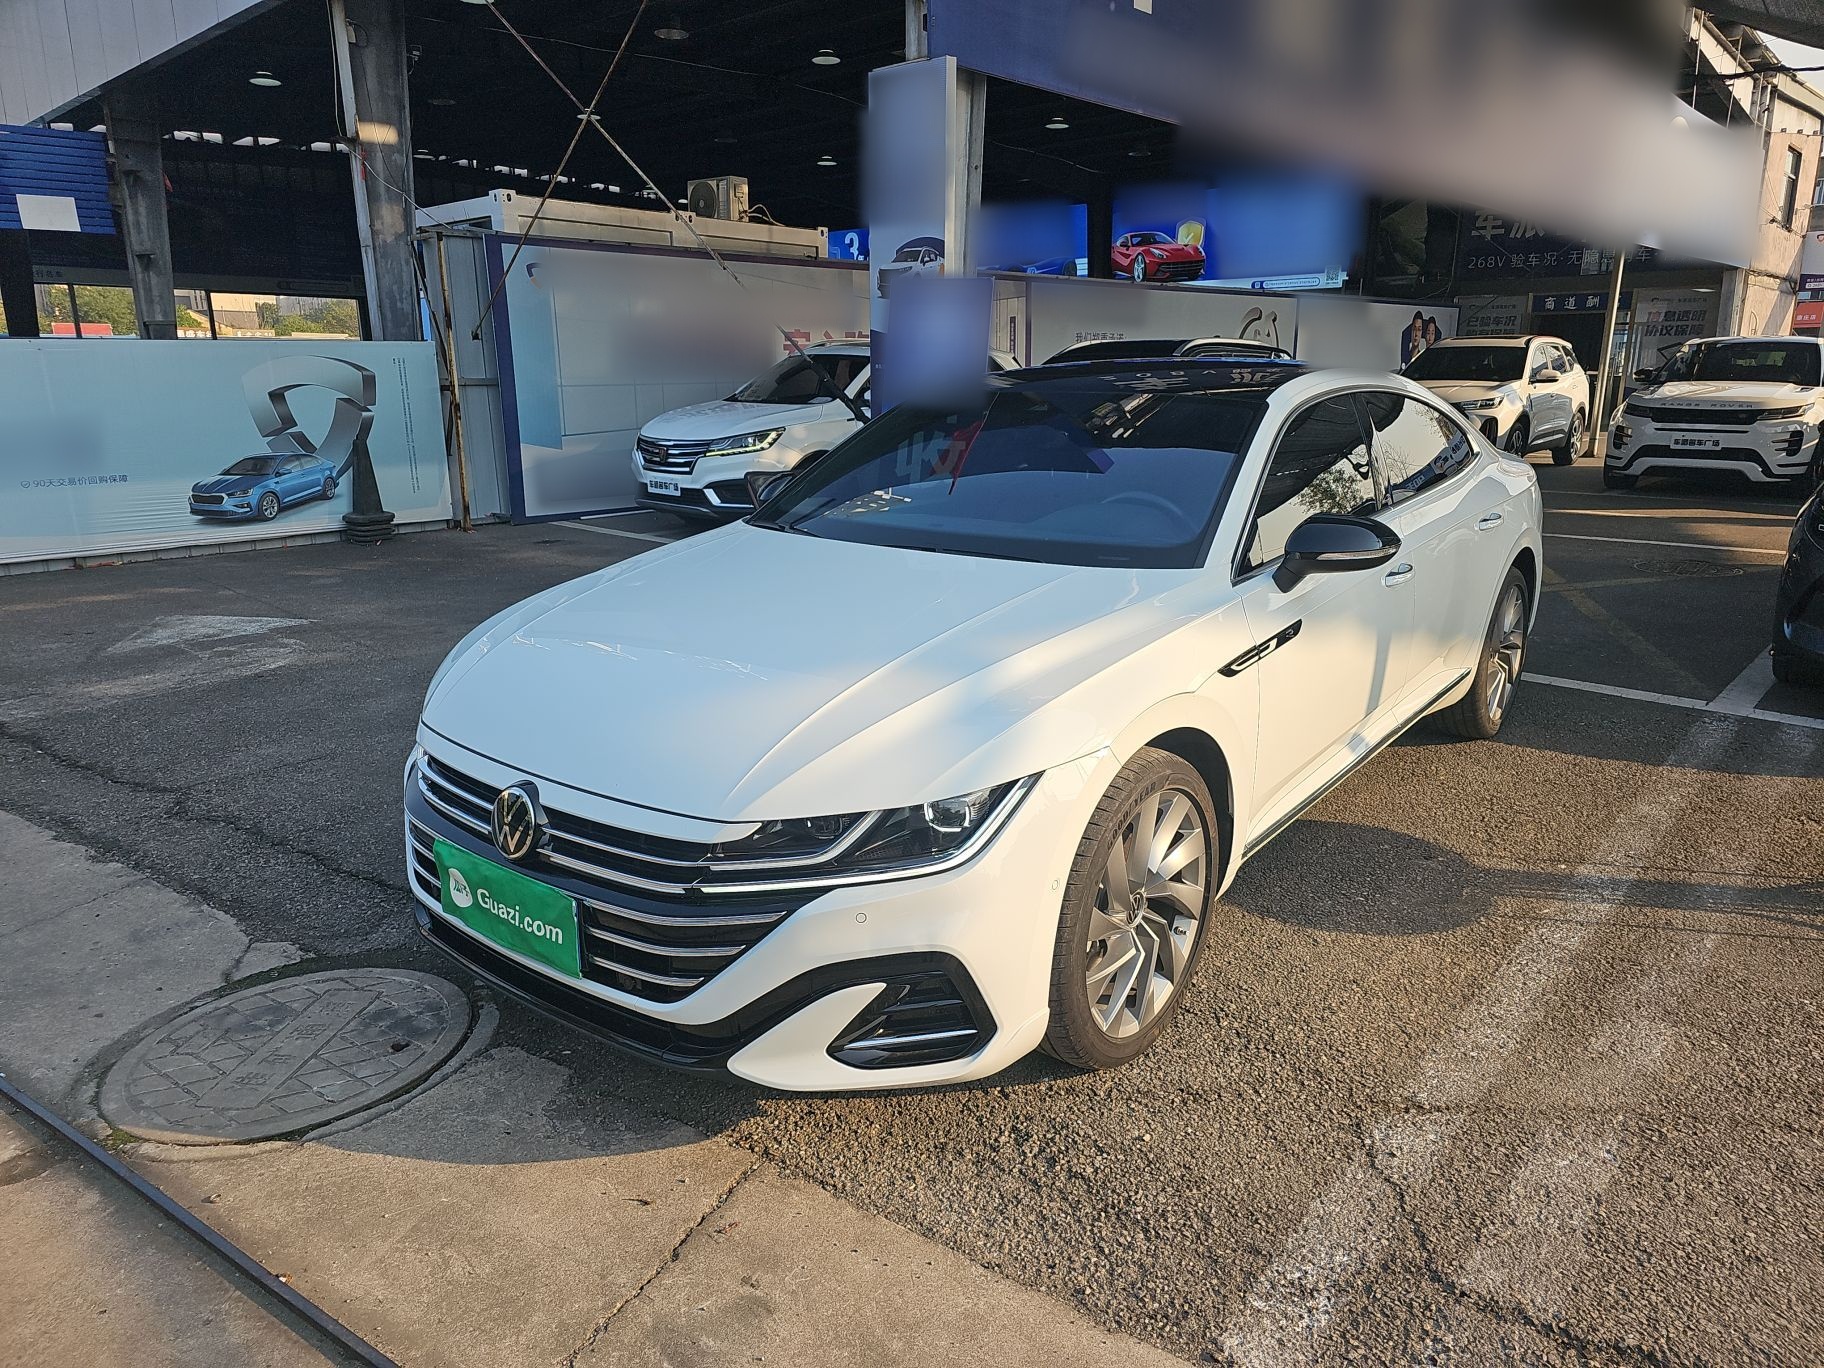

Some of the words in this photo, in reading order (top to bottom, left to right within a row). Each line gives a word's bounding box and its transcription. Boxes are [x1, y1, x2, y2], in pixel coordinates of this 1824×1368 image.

[1468, 257, 1506, 268] 268V
[1545, 296, 1622, 310] 商道酬
[33, 475, 128, 488] 90天交易价回购保障
[476, 888, 563, 945] Guazi.com
